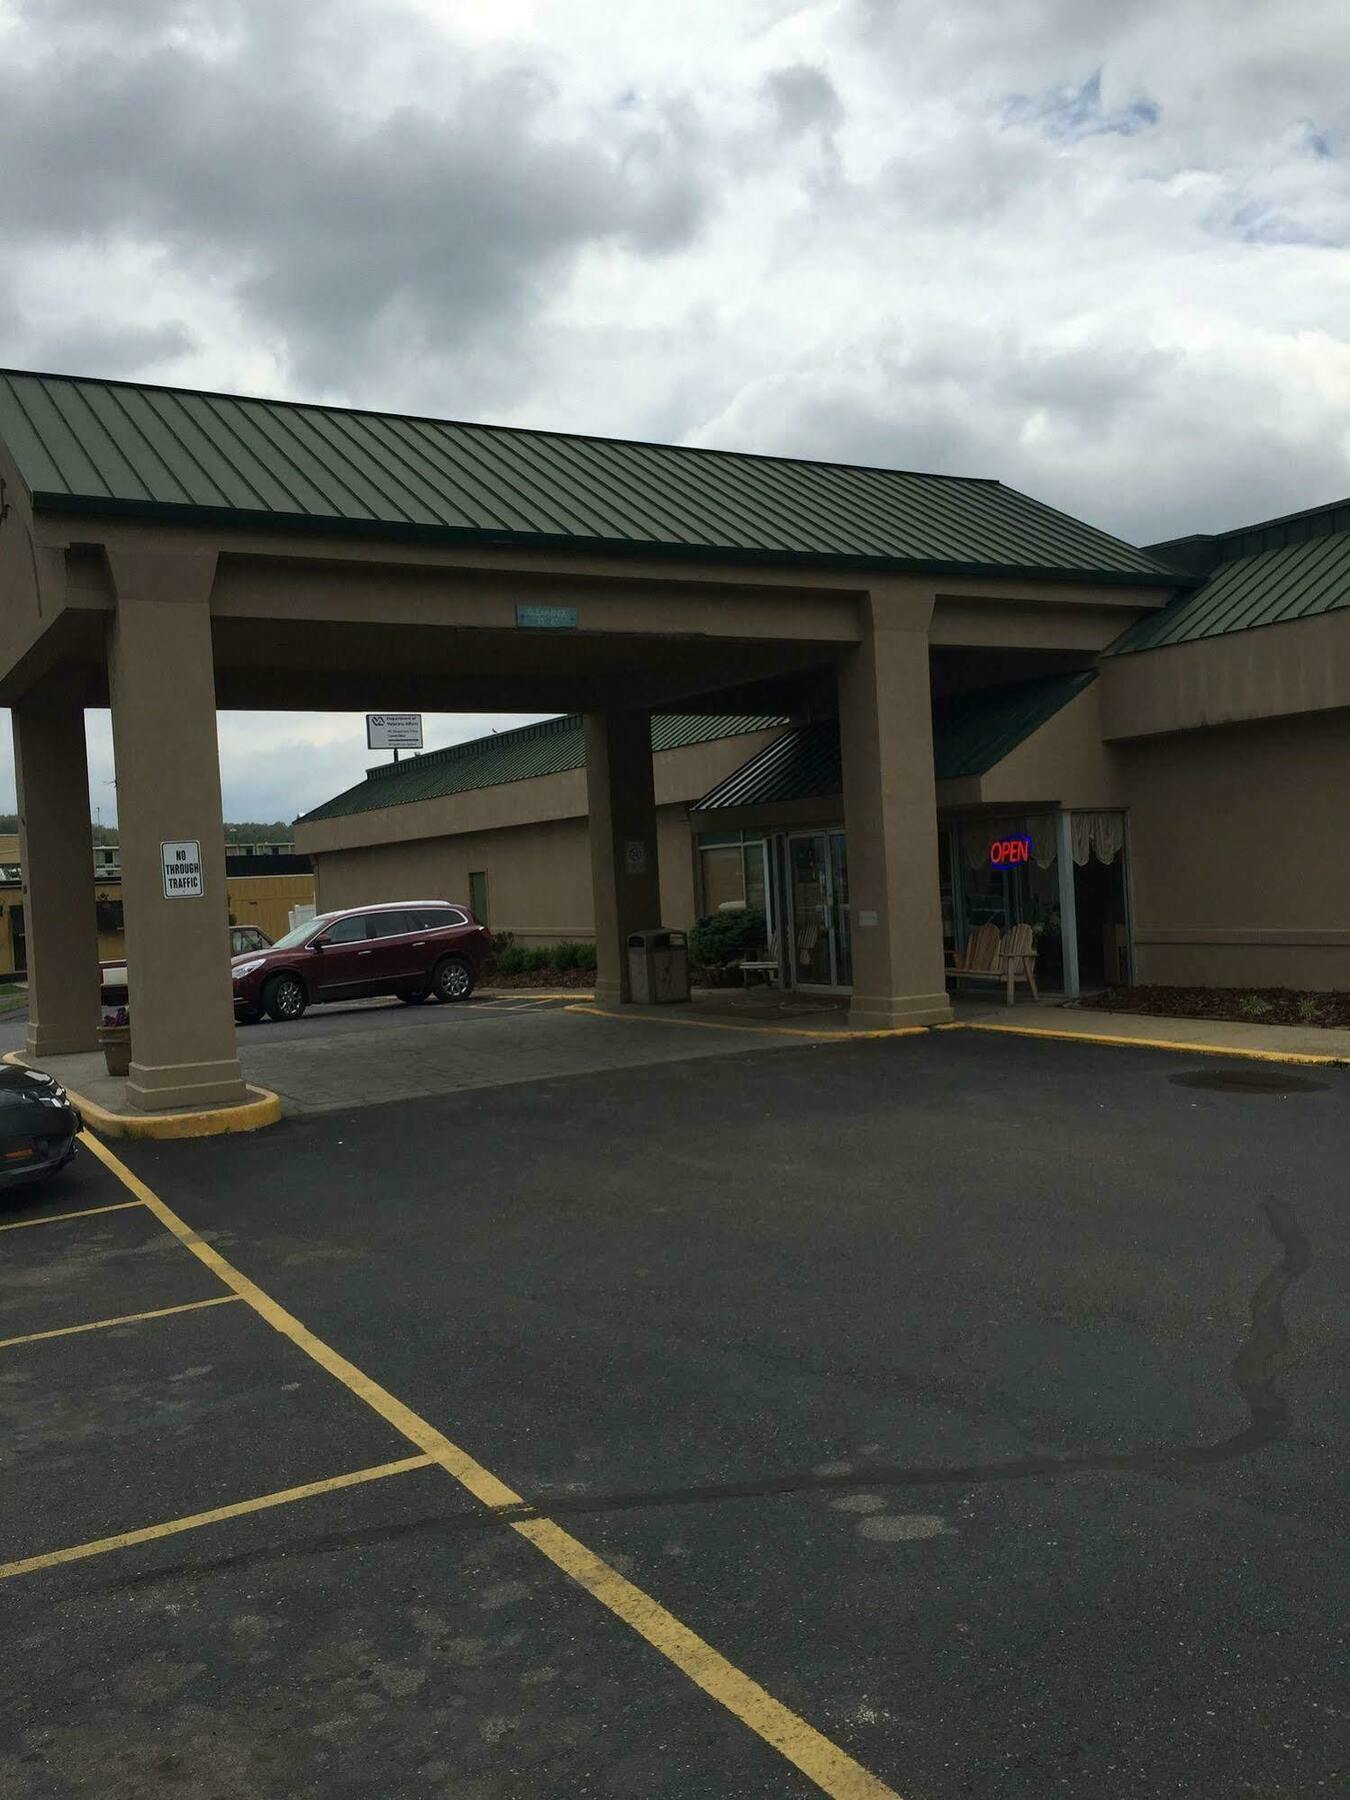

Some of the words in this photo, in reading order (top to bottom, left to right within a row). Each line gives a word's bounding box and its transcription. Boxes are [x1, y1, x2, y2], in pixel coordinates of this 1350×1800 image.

[176, 850, 186, 861] NO
[991, 840, 1029, 863] OPEN
[166, 863, 199, 875] THROUGH
[168, 877, 198, 889] TRAFFIC
